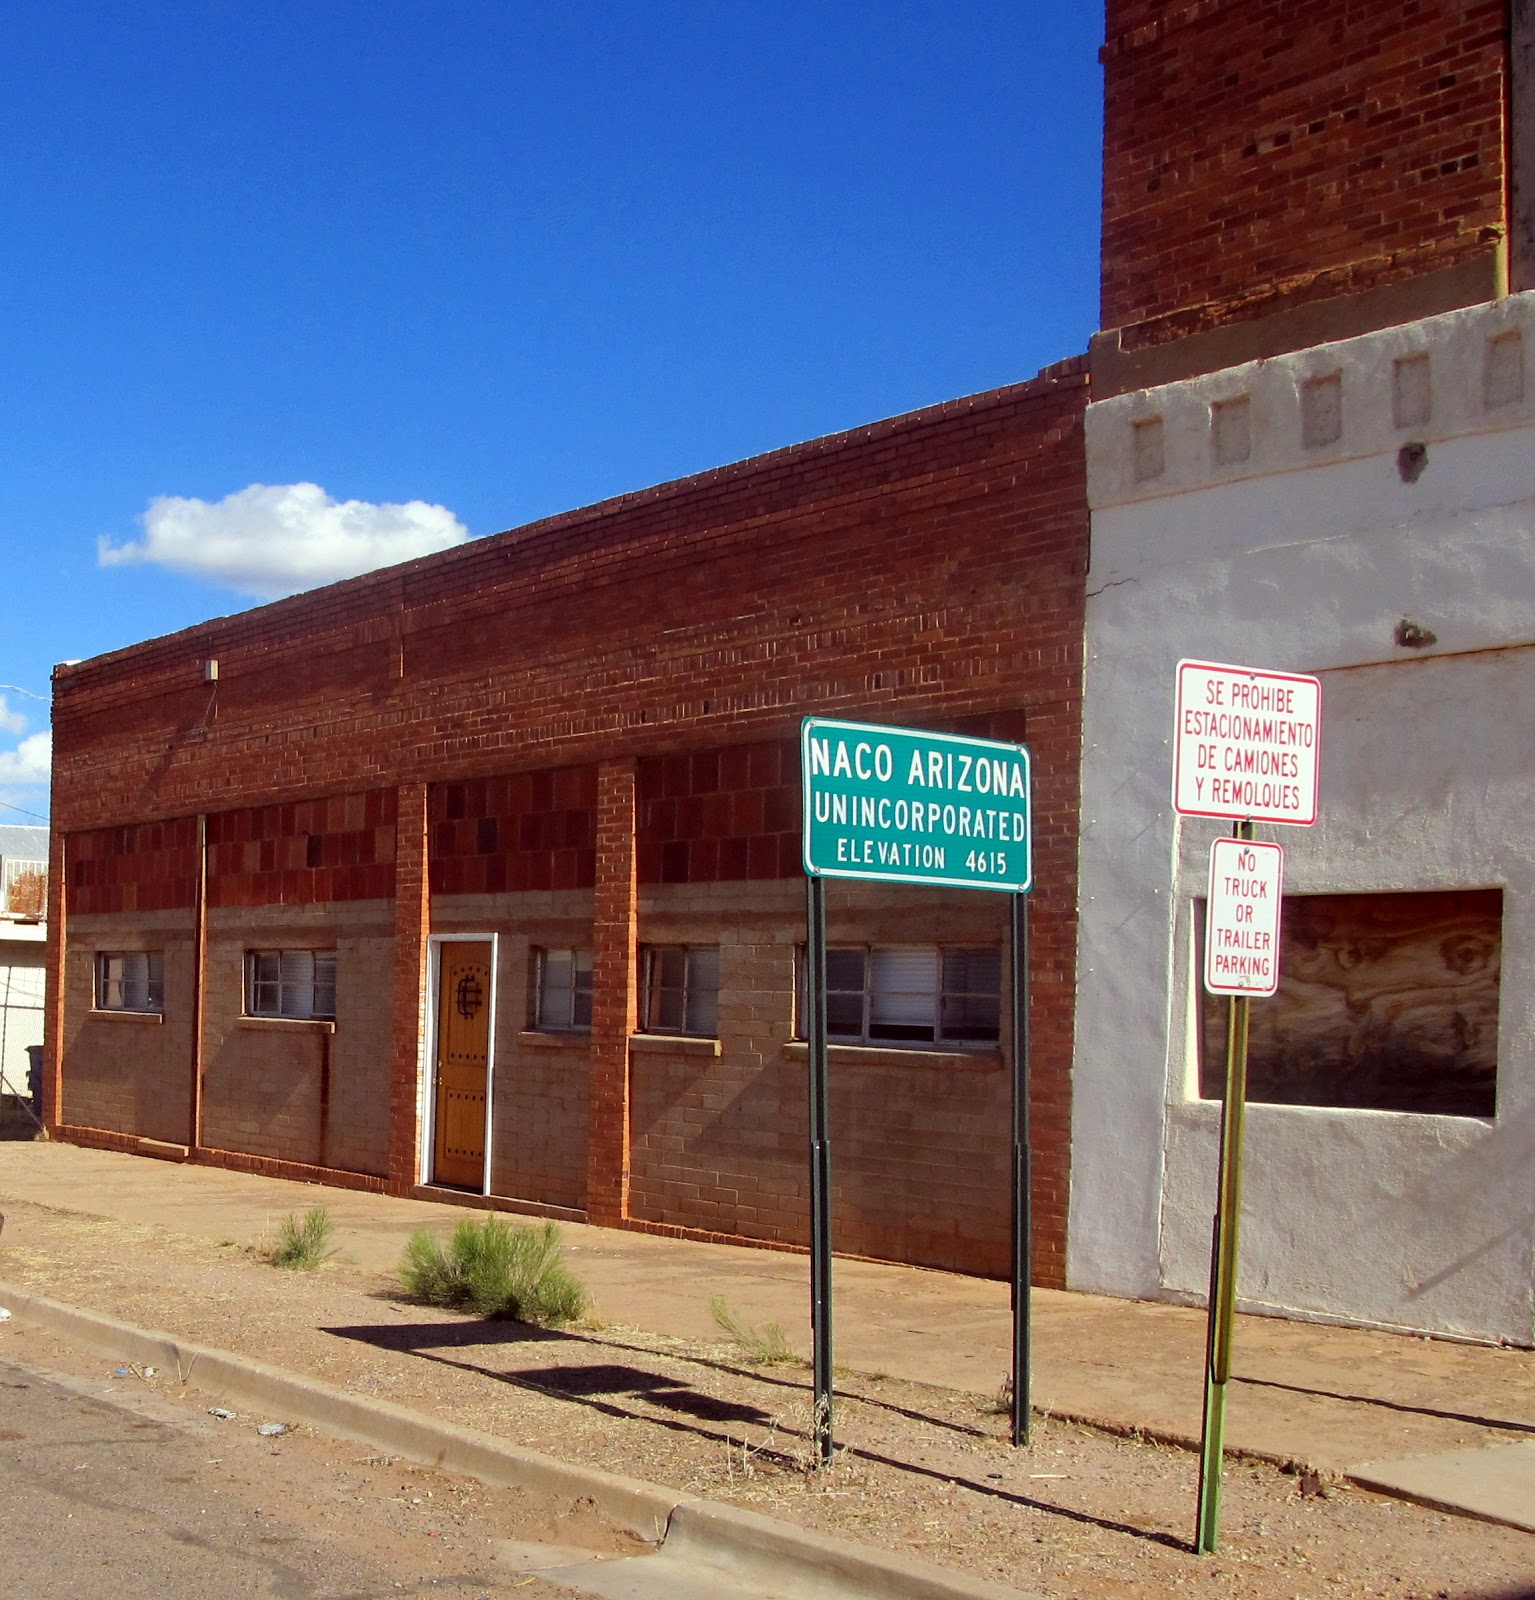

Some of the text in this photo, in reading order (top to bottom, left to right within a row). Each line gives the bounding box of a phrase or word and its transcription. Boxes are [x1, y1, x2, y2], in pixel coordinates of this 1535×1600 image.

[1205, 679, 1294, 713] SE PROHIBE
[1184, 709, 1313, 748] ESTACIONAMIENTO
[810, 737, 1025, 799] NACO ARIZONA
[1197, 744, 1298, 778] DE CAMIONES
[1194, 776, 1300, 810] Y REMOLQUES
[814, 791, 1025, 842] UNINCORPORATED
[836, 838, 1007, 875] ELEVATION 4615
[1237, 853, 1256, 872] NO
[1224, 877, 1267, 899] TRUCK
[1235, 904, 1253, 923] OR
[1216, 928, 1271, 950] TRAILER
[1214, 954, 1270, 976] PARKING
